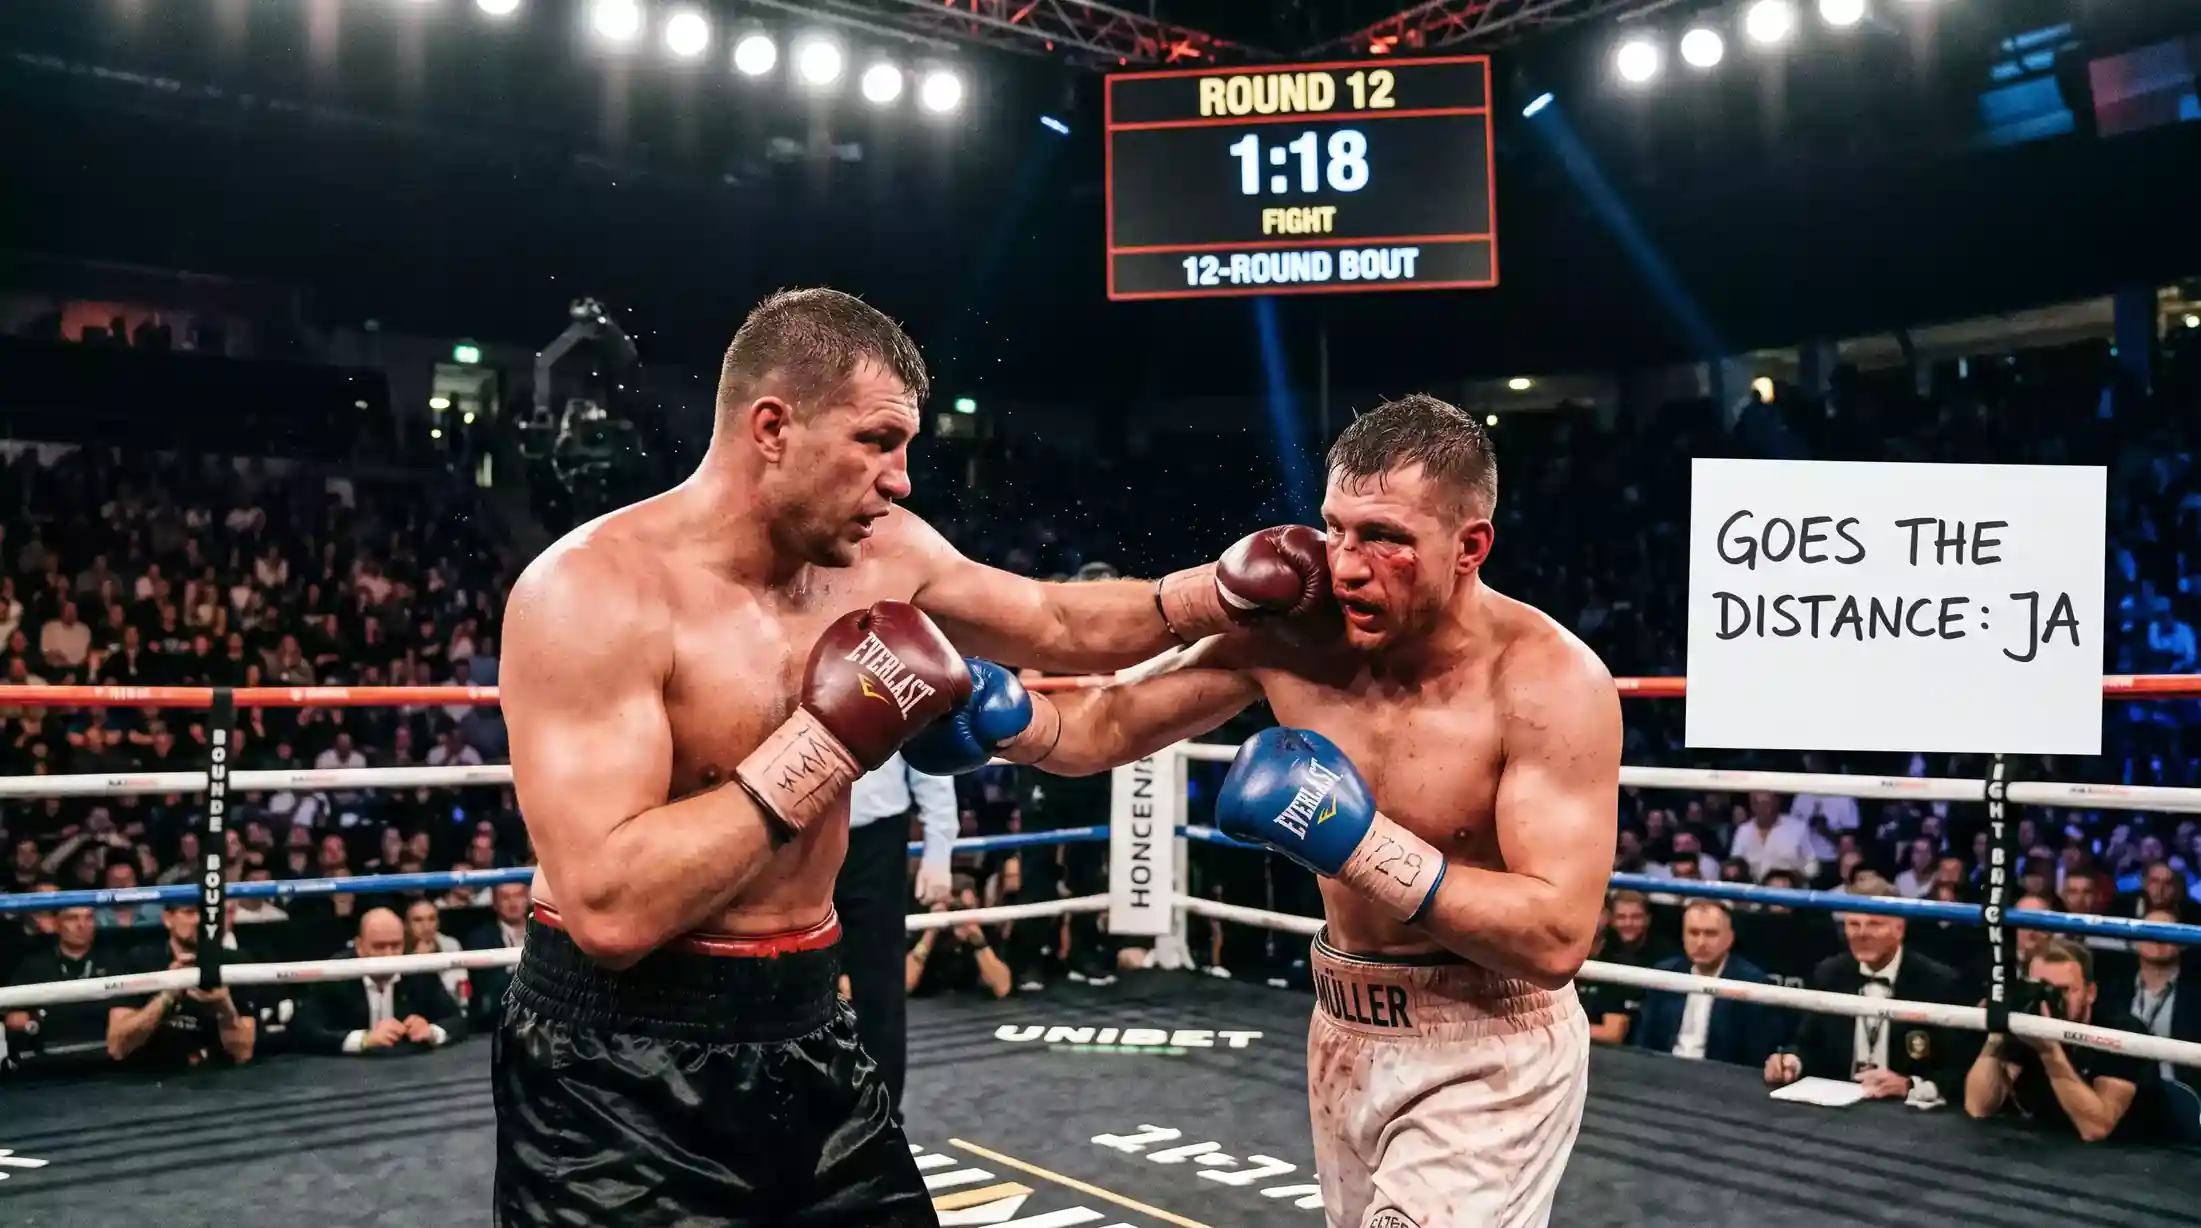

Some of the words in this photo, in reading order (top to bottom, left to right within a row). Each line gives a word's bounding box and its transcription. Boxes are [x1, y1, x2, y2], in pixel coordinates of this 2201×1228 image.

[1200, 73, 1335, 117] ROUND
[1346, 69, 1395, 110] 12
[1230, 130, 1370, 195] 1:18
[1262, 206, 1337, 235] FIGHT
[1183, 251, 1333, 286] 12-ROUND
[1339, 248, 1419, 281] BOUT
[1717, 510, 1866, 571] GOES
[1895, 517, 2008, 567] THE
[1712, 591, 1990, 642] DISTANCE:
[2003, 591, 2080, 662] JA
[844, 631, 936, 721] EVERLAST
[1273, 757, 1343, 840] EVERLAST
[994, 1025, 1264, 1048] UNIBET
